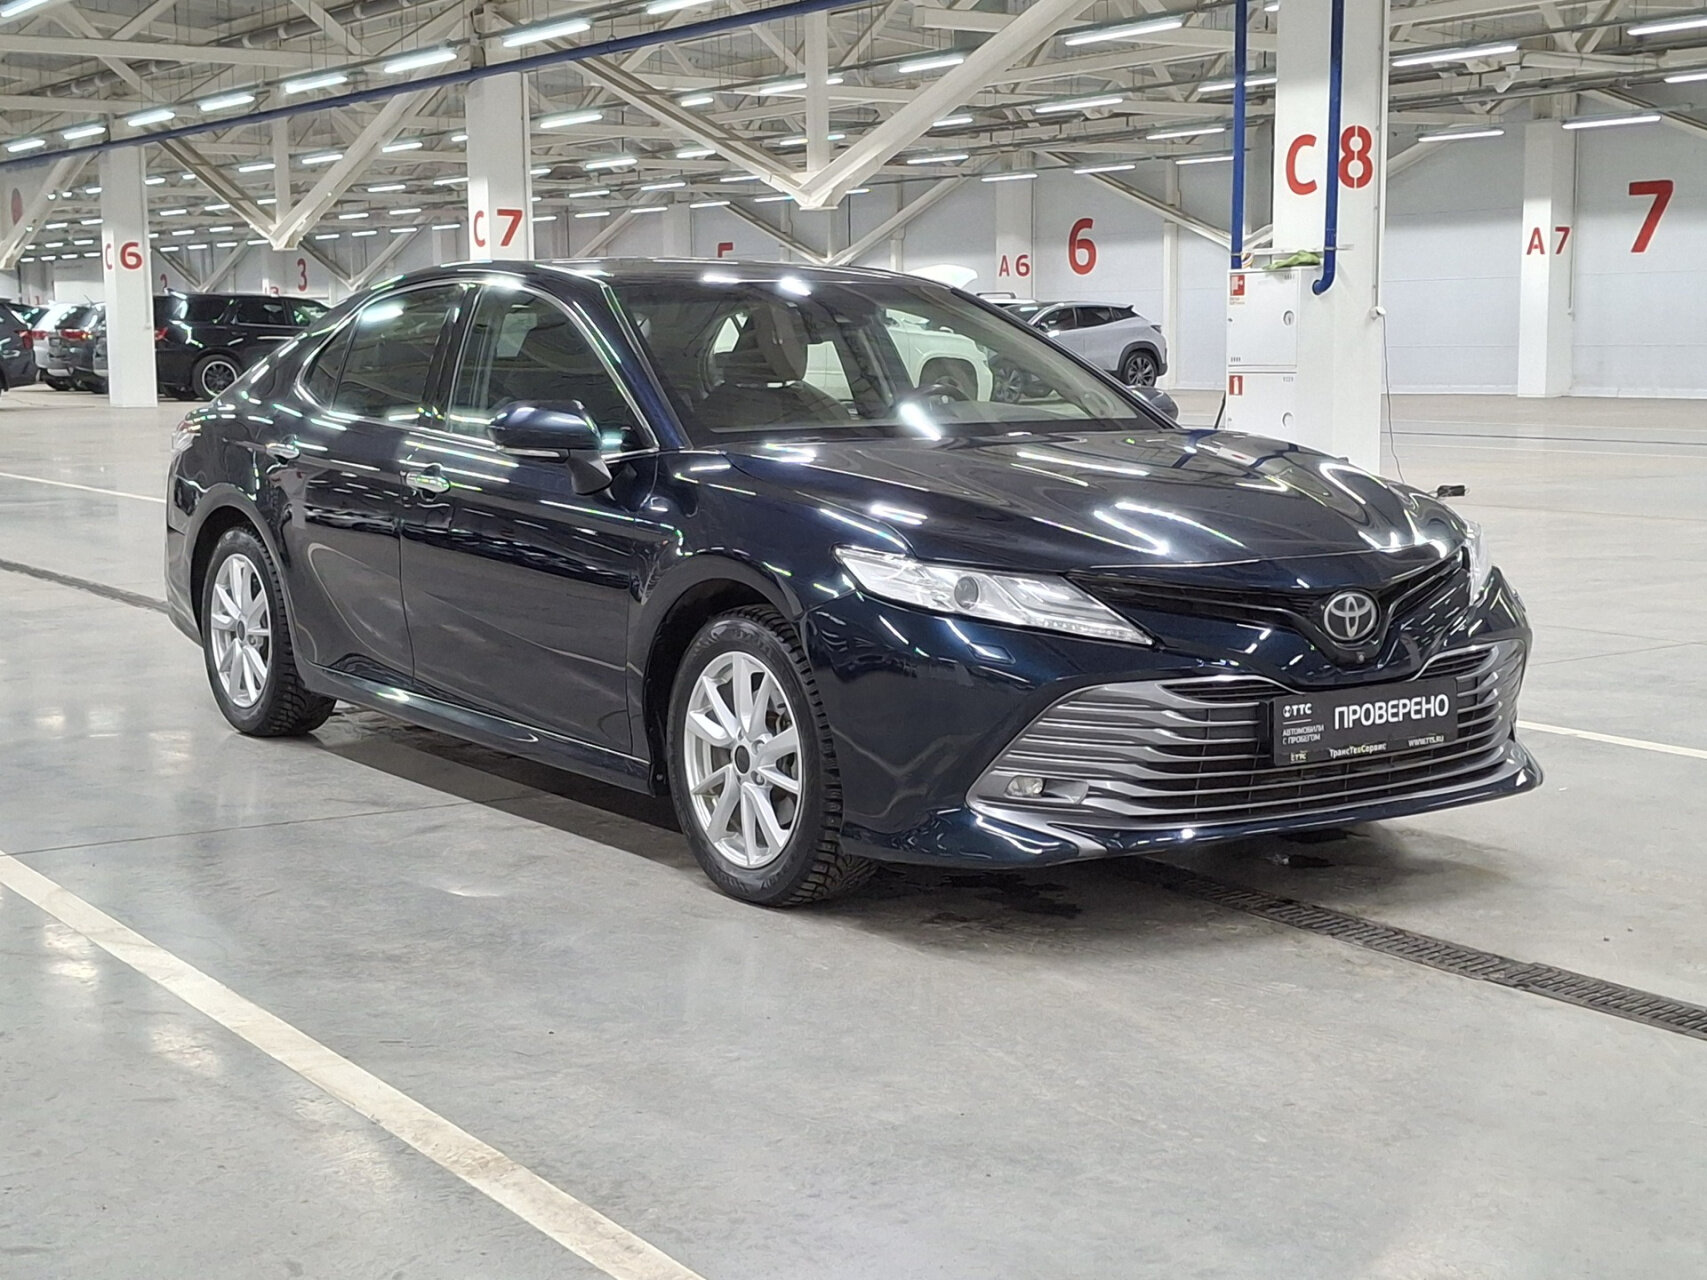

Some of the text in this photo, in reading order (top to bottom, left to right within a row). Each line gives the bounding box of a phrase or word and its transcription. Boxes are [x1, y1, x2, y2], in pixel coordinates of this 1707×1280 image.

[1338, 125, 1373, 188] 8
[497, 208, 523, 247] 7
[1629, 180, 1673, 253] 7
[120, 242, 143, 270] 6
[1069, 217, 1097, 275] 6
[1555, 226, 1571, 255] 7
[297, 258, 308, 292] 3
[1016, 254, 1030, 277] 6
[1334, 694, 1449, 730] ПРОВЕРЕНО
